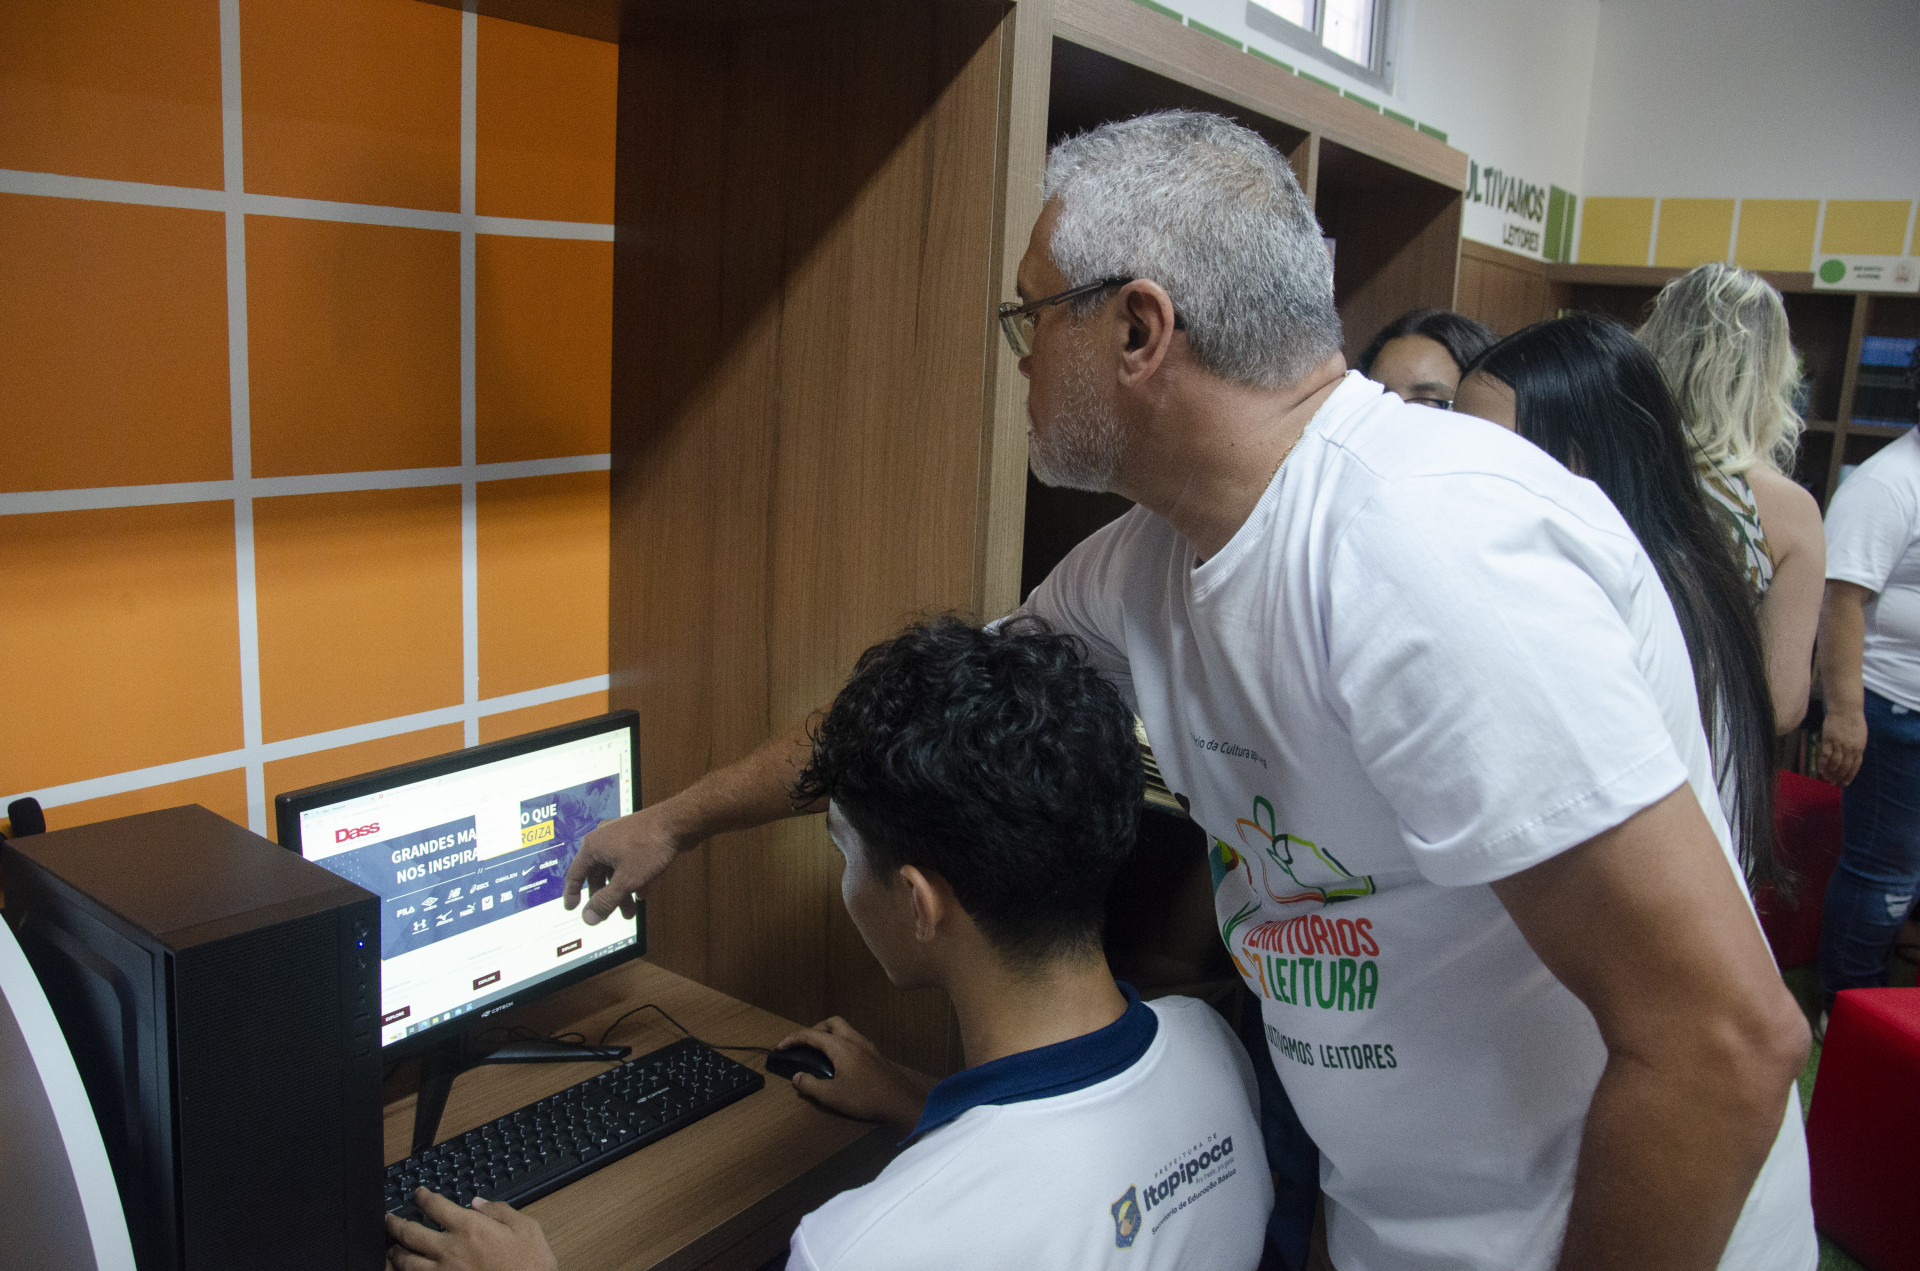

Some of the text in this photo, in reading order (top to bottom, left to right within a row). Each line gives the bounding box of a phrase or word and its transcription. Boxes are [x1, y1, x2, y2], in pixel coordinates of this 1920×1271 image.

[1206, 739, 1219, 751] da
[1220, 742, 1250, 758] Cultura
[335, 822, 381, 843] Dass
[391, 834, 455, 864] GRANDES
[457, 827, 477, 845] MA
[532, 803, 557, 823] QUE
[396, 863, 426, 884] NOS
[397, 905, 416, 918] FILA
[1266, 955, 1379, 1012] LEITURA
[1320, 1044, 1397, 1070] LEITORES
[1154, 1142, 1203, 1179] PREFEITURA
[1207, 1132, 1218, 1143] DE
[1143, 1136, 1233, 1212] Itapipoca
[1178, 1201, 1187, 1210] de
[1187, 1181, 1217, 1205] Educação
[1217, 1168, 1237, 1184] Básica
